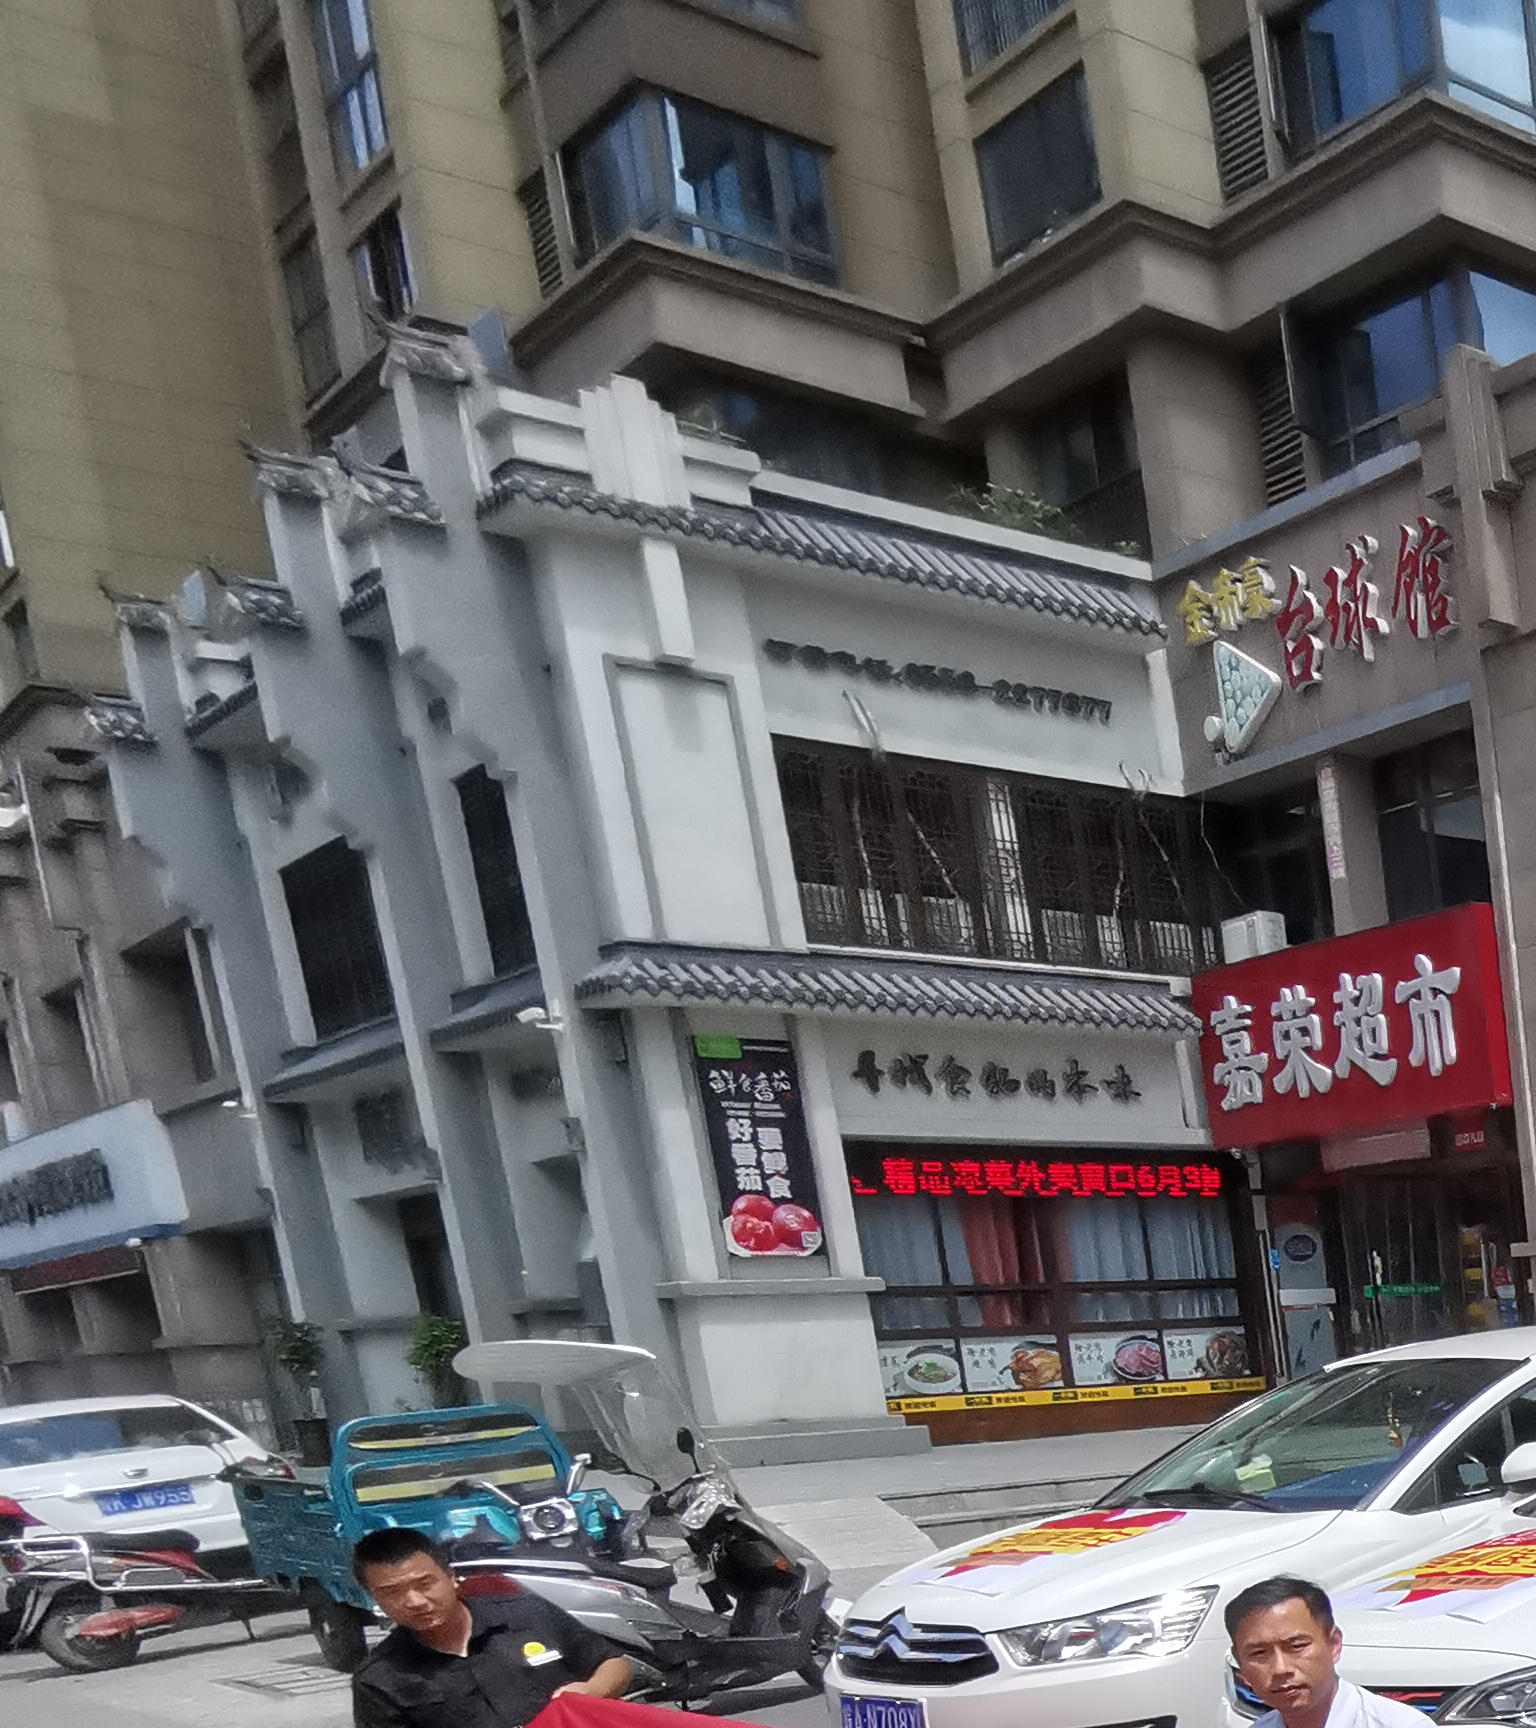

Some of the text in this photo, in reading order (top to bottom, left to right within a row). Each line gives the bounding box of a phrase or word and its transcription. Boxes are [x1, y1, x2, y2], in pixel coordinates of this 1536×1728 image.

[1277, 516, 1458, 690] 台球馆
[1210, 953, 1461, 1111] 嘉荣超市
